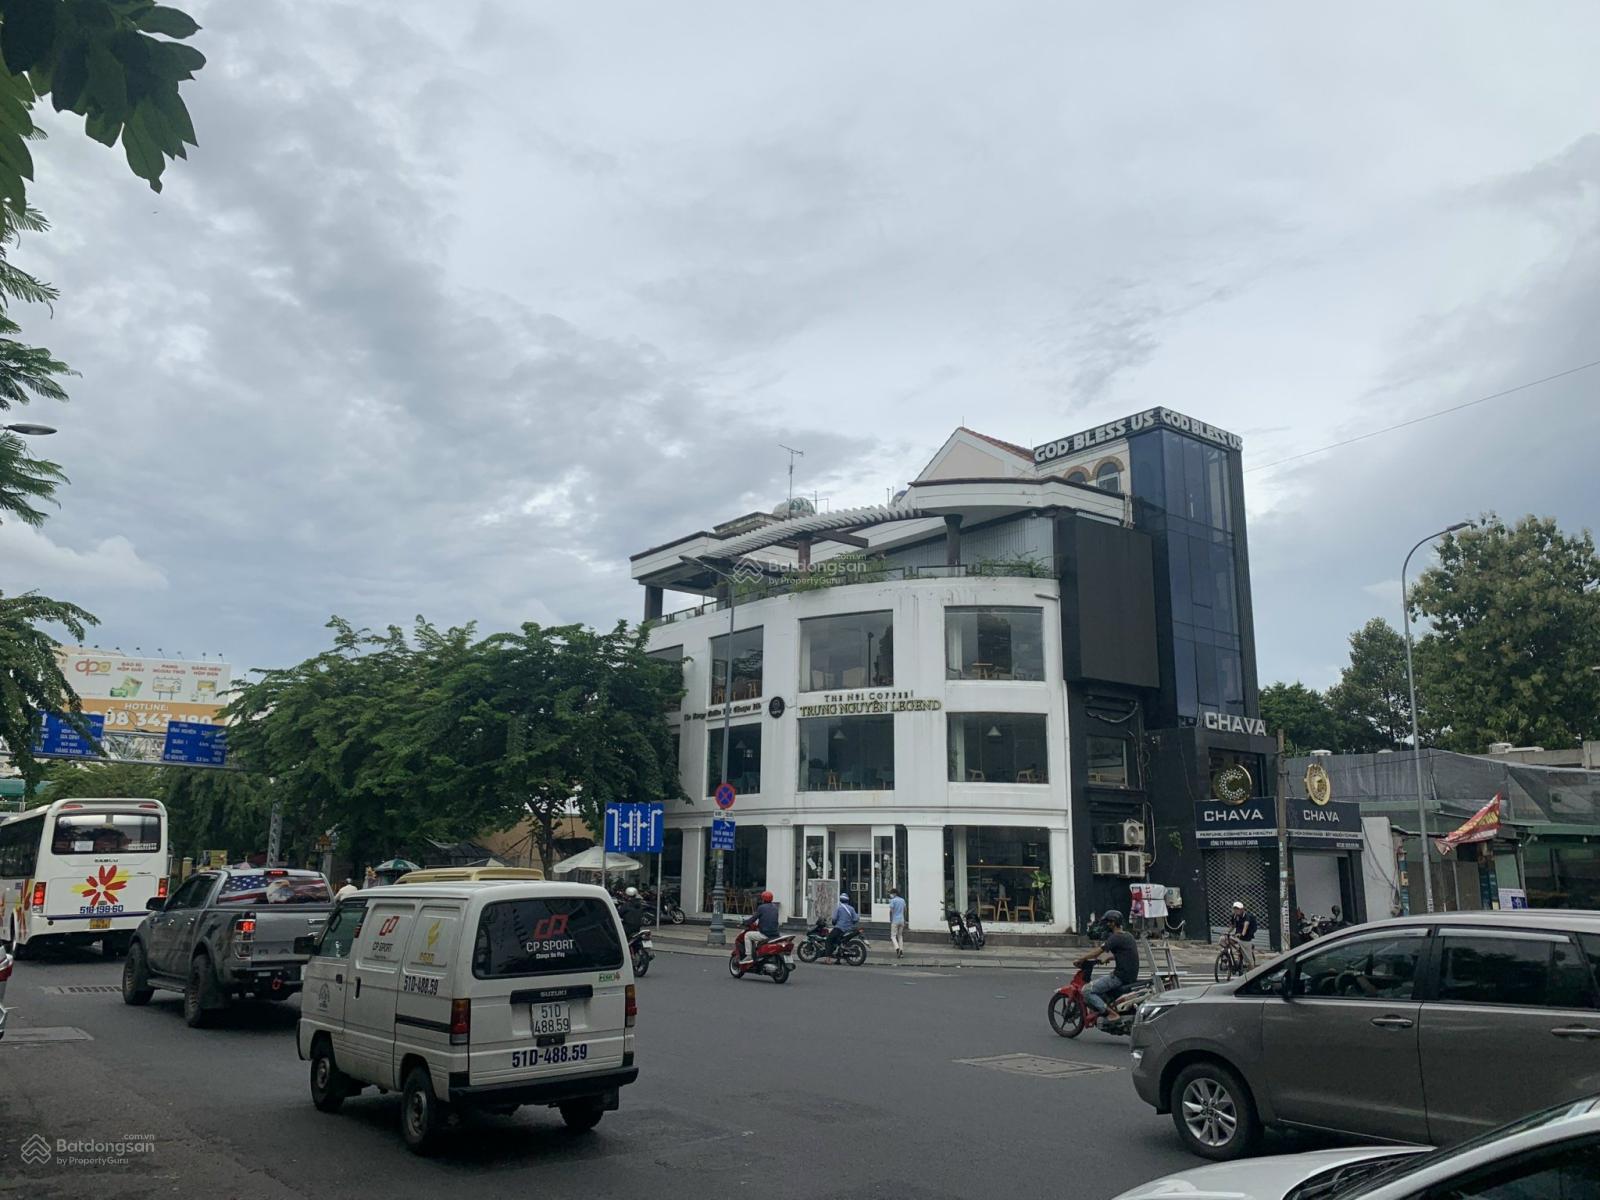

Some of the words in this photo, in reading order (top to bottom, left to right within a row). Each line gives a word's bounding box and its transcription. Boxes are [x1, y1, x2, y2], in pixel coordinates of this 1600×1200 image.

[1034, 438, 1069, 462] GOD
[1073, 419, 1128, 449] BLESS
[1131, 410, 1155, 429] US
[1160, 408, 1190, 432] GOD
[1191, 419, 1229, 446] BLESS
[1228, 432, 1243, 451] US
[824, 694, 843, 703] THE
[125, 702, 169, 712] HOTLINE:
[800, 703, 838, 717] TRUNG
[840, 699, 888, 714] NGUYÊN
[890, 698, 942, 712] LEGEND
[1204, 711, 1267, 736] CHAVA
[1204, 809, 1264, 822] CHAVA
[1303, 809, 1340, 823] CHAVA
[526, 941, 542, 952] CP
[542, 939, 575, 951] SPORT
[542, 1004, 561, 1018] 51D
[534, 1018, 570, 1034] 488.59
[512, 1043, 588, 1068] 51D-488.59
